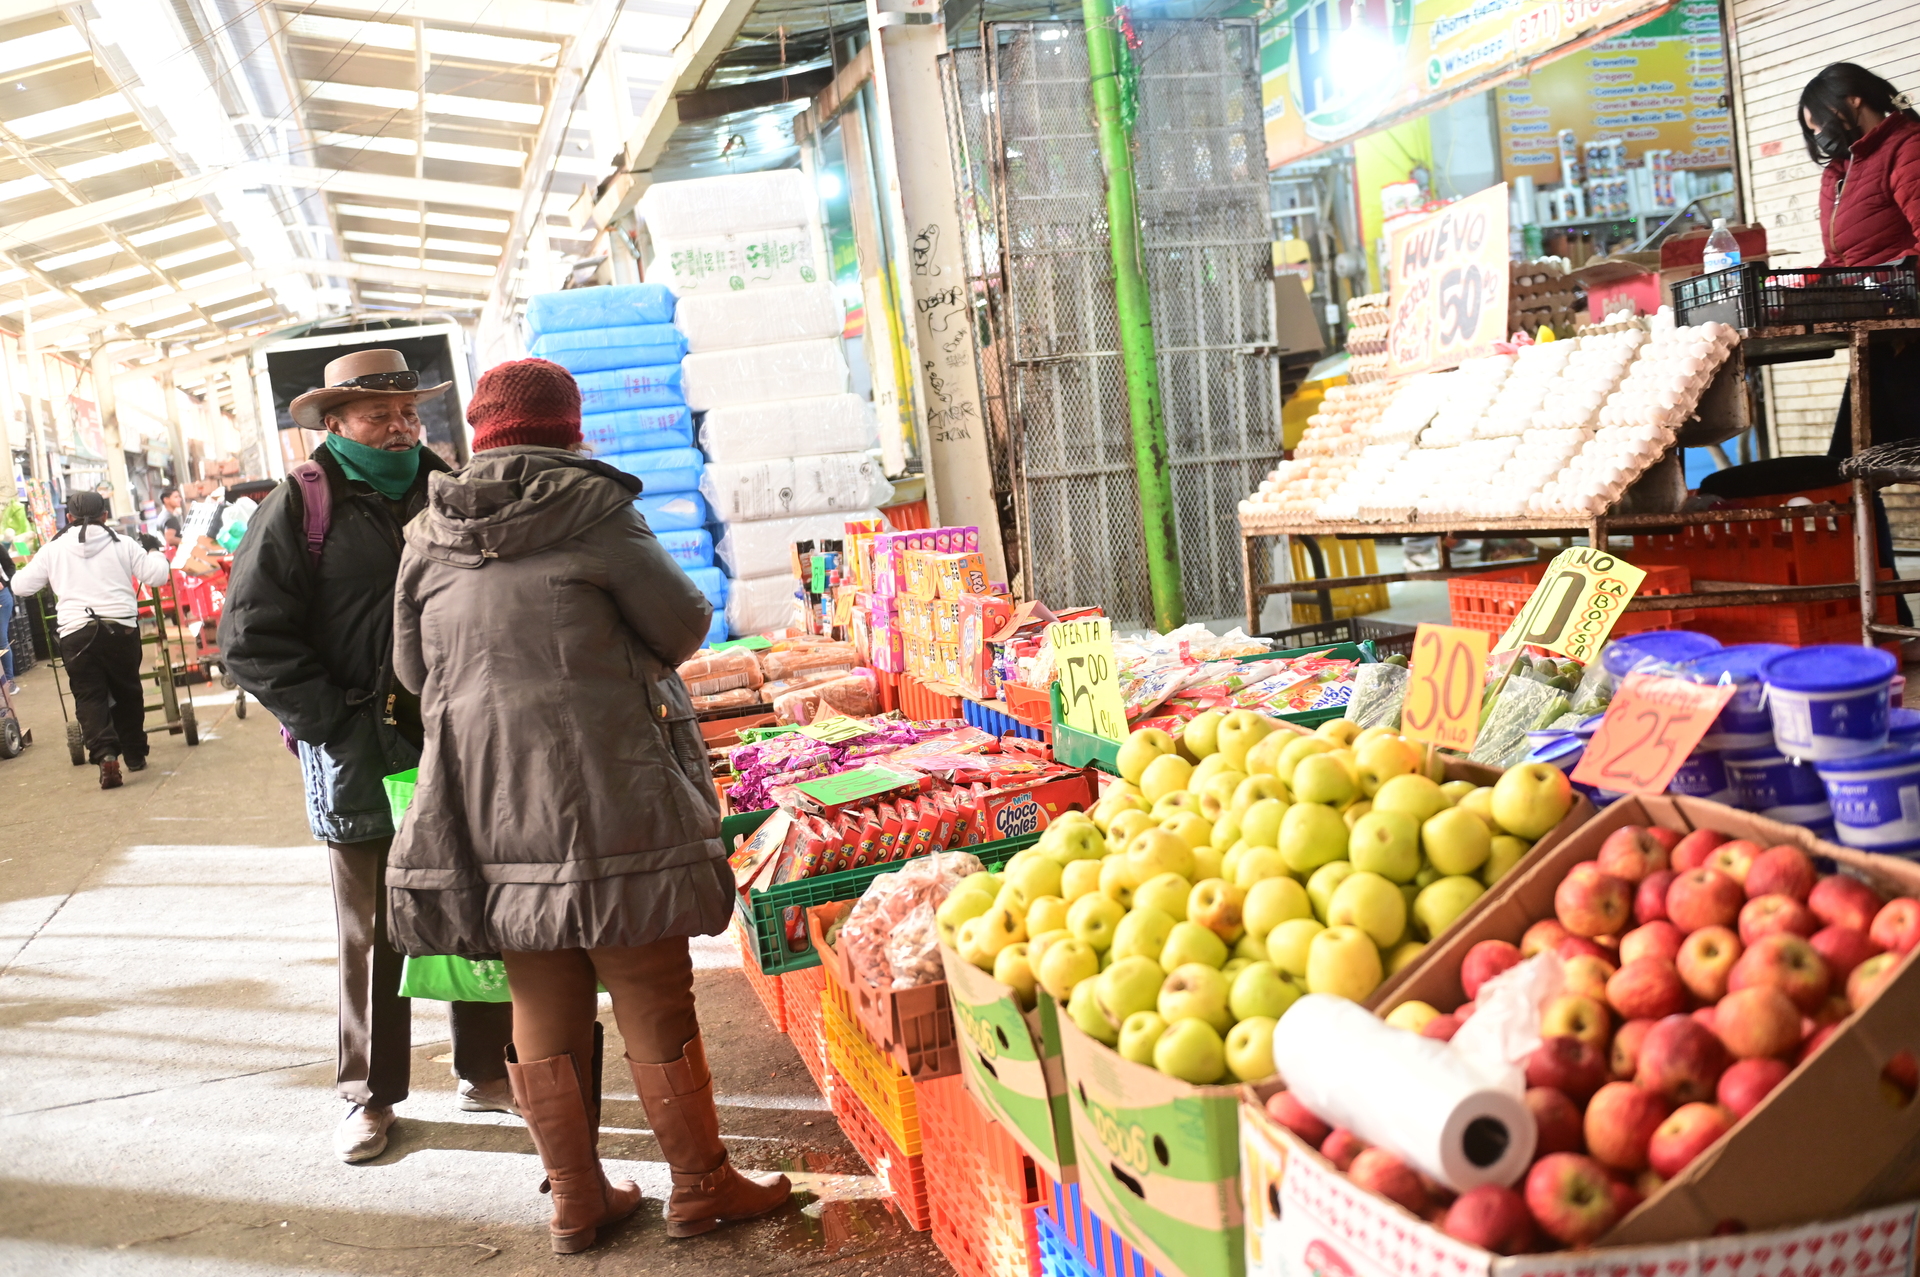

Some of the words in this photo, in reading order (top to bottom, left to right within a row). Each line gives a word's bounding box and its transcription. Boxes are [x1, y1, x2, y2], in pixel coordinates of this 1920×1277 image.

[1402, 213, 1486, 279] HUEVO
[968, 570, 988, 594] Pay
[1599, 580, 1622, 596] LA
[1051, 620, 1101, 650] OFERTA
[1573, 594, 1609, 658] BOLSA
[1406, 631, 1476, 730] 30
[1012, 792, 1032, 806] Mini
[996, 802, 1038, 831] Choco
[1003, 815, 1037, 839] Roles
